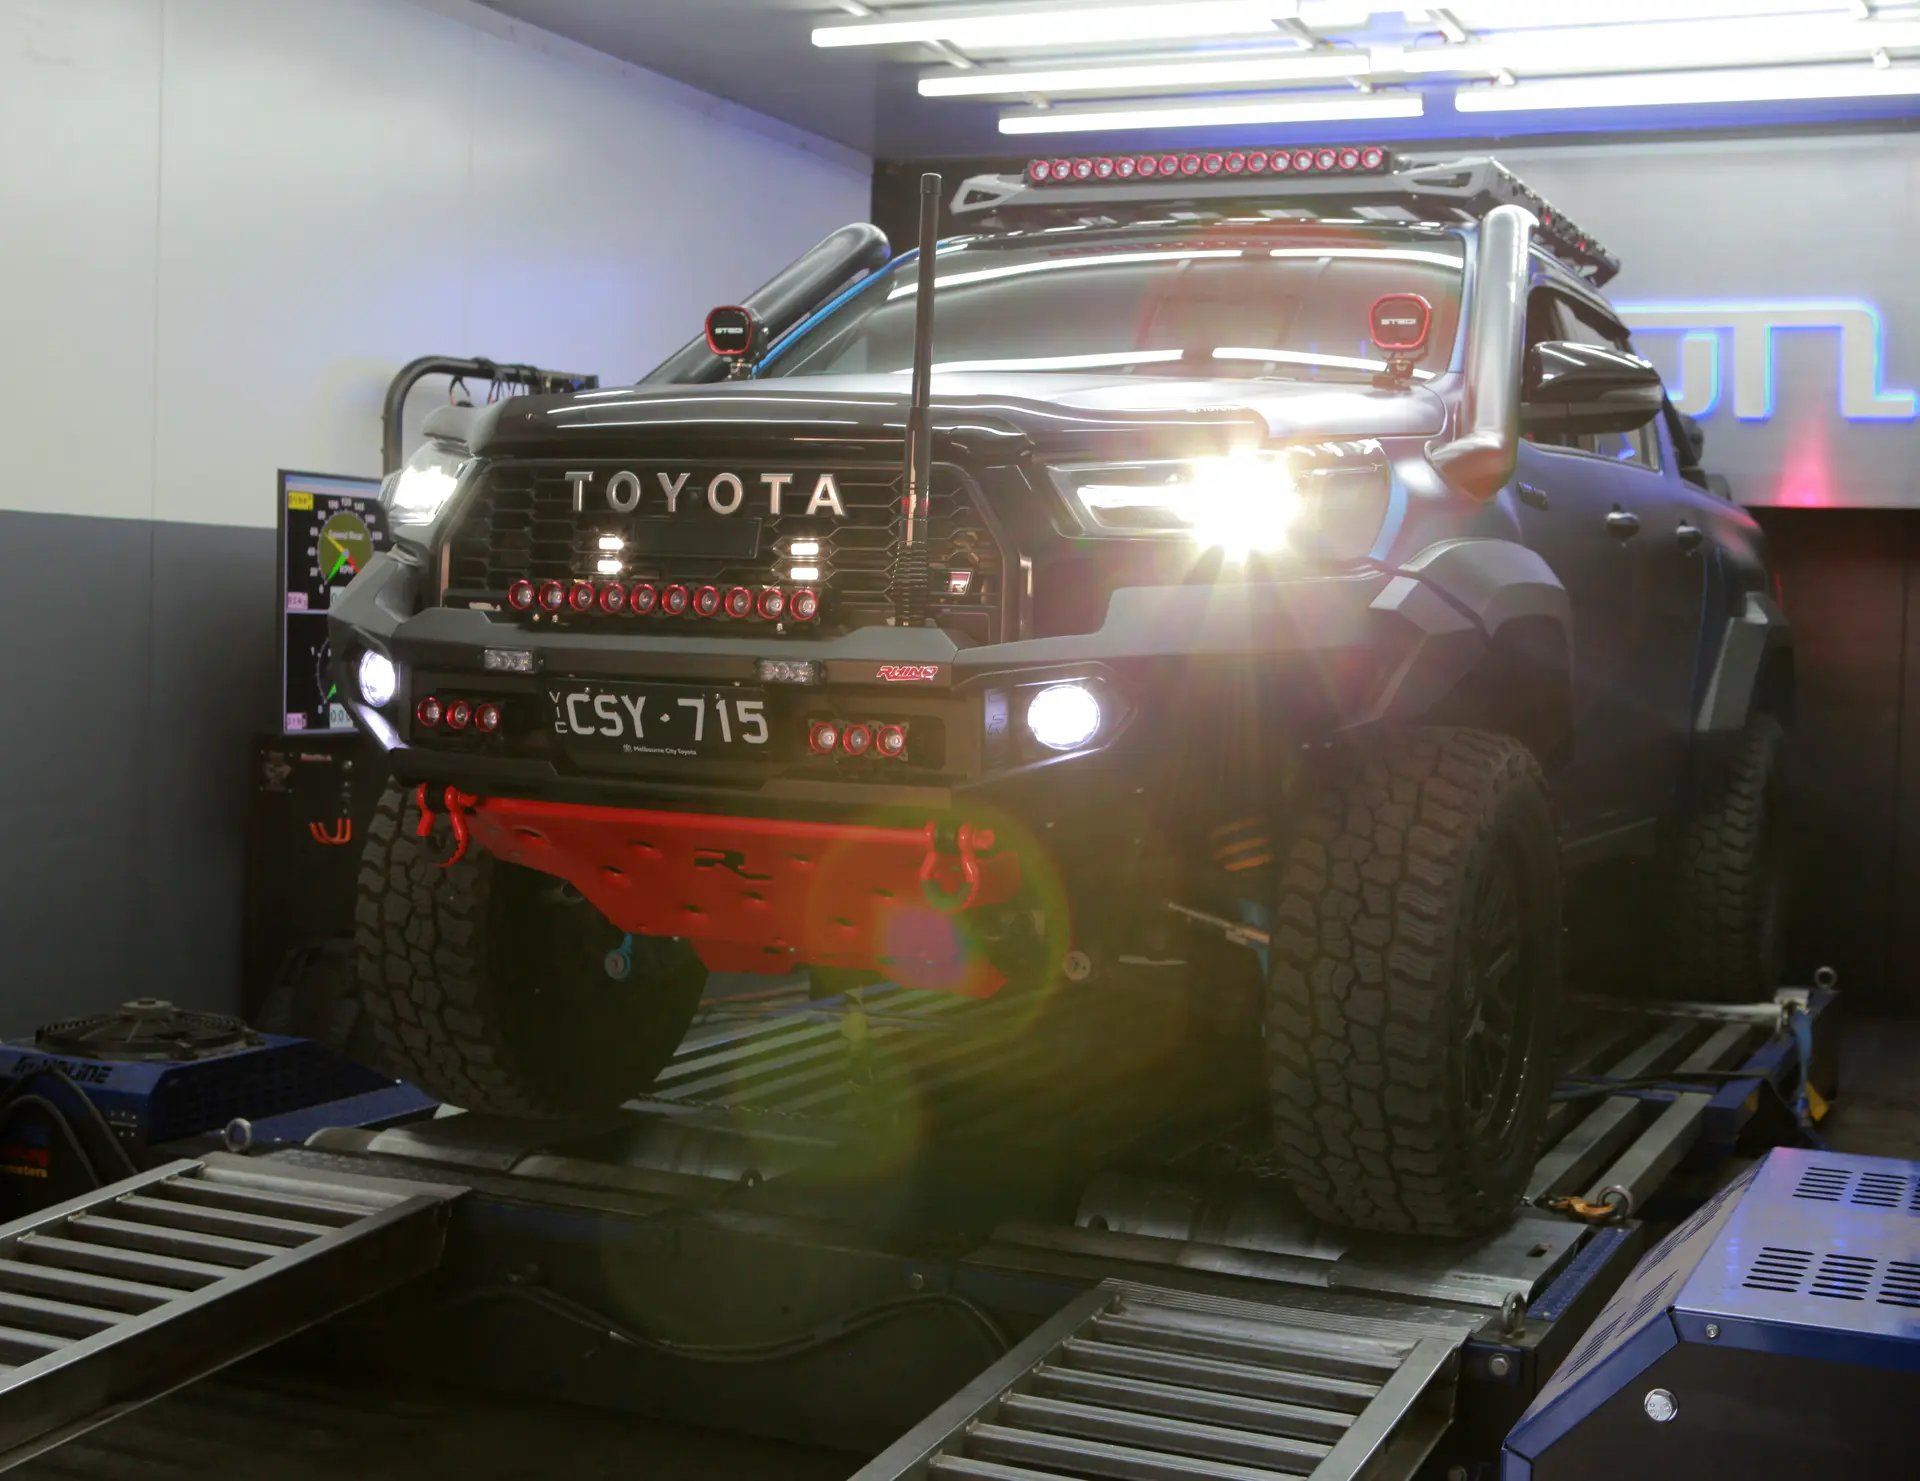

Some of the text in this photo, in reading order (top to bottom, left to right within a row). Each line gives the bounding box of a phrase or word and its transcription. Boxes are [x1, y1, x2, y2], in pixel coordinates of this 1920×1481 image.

[565, 471, 846, 516] TOYOTA
[566, 692, 769, 744] CSY 715
